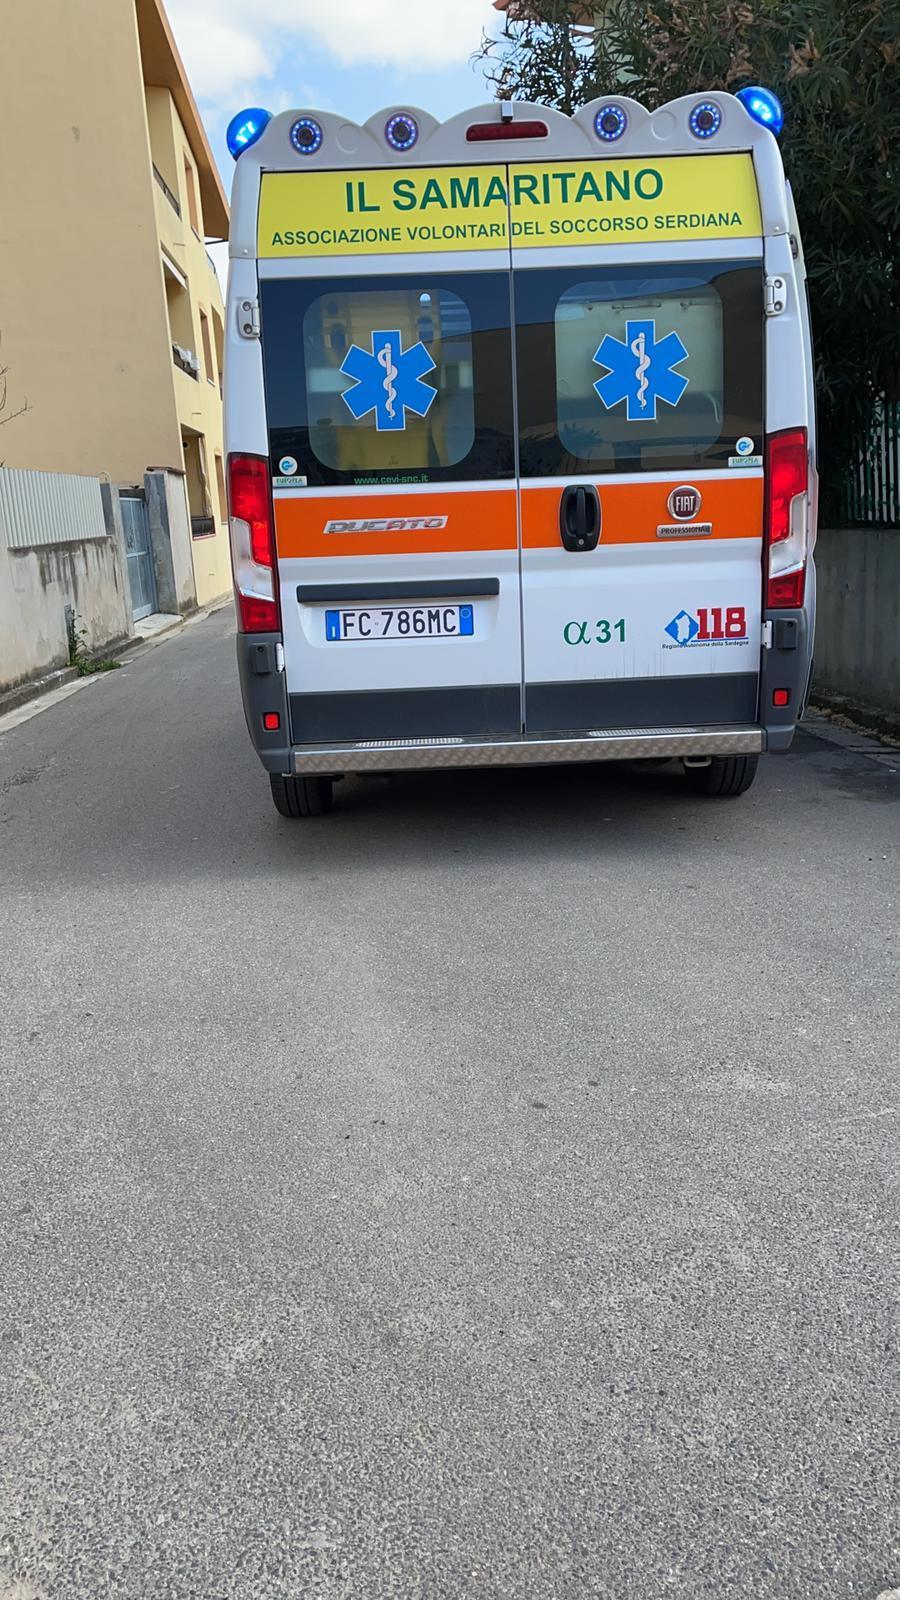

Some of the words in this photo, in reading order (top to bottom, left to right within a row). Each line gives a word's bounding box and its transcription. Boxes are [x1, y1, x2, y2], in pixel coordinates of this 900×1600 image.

[345, 181, 380, 213] IL
[392, 168, 664, 211] SAMARITANO
[271, 227, 402, 246] ASSOCIAZIONE
[407, 223, 506, 241] VOLONTARI
[511, 221, 545, 236] DEL
[550, 216, 649, 234] SOCCORSO
[653, 212, 742, 229] SERDIANA
[353, 473, 430, 485] www.cevi-snc.it
[675, 495, 695, 512] FIAT
[328, 517, 444, 534] DUCATO
[660, 525, 711, 535] PROFESSIONA
[696, 606, 747, 640] 118
